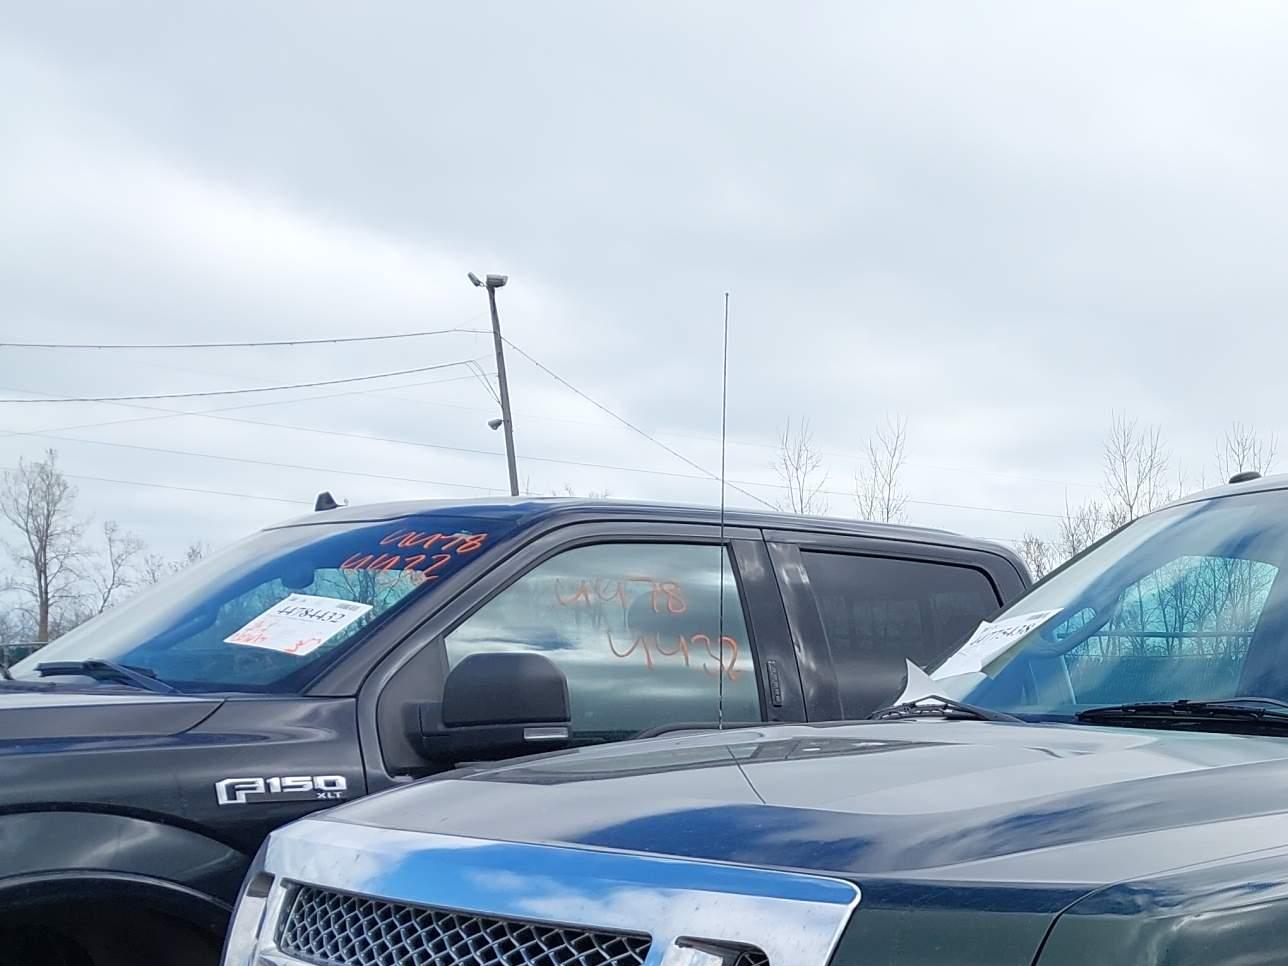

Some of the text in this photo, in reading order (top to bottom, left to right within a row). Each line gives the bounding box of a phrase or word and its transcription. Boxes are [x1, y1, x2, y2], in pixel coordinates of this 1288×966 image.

[277, 605, 346, 624] 44784432
[606, 631, 743, 681] 4432
[317, 791, 343, 800] XLT
